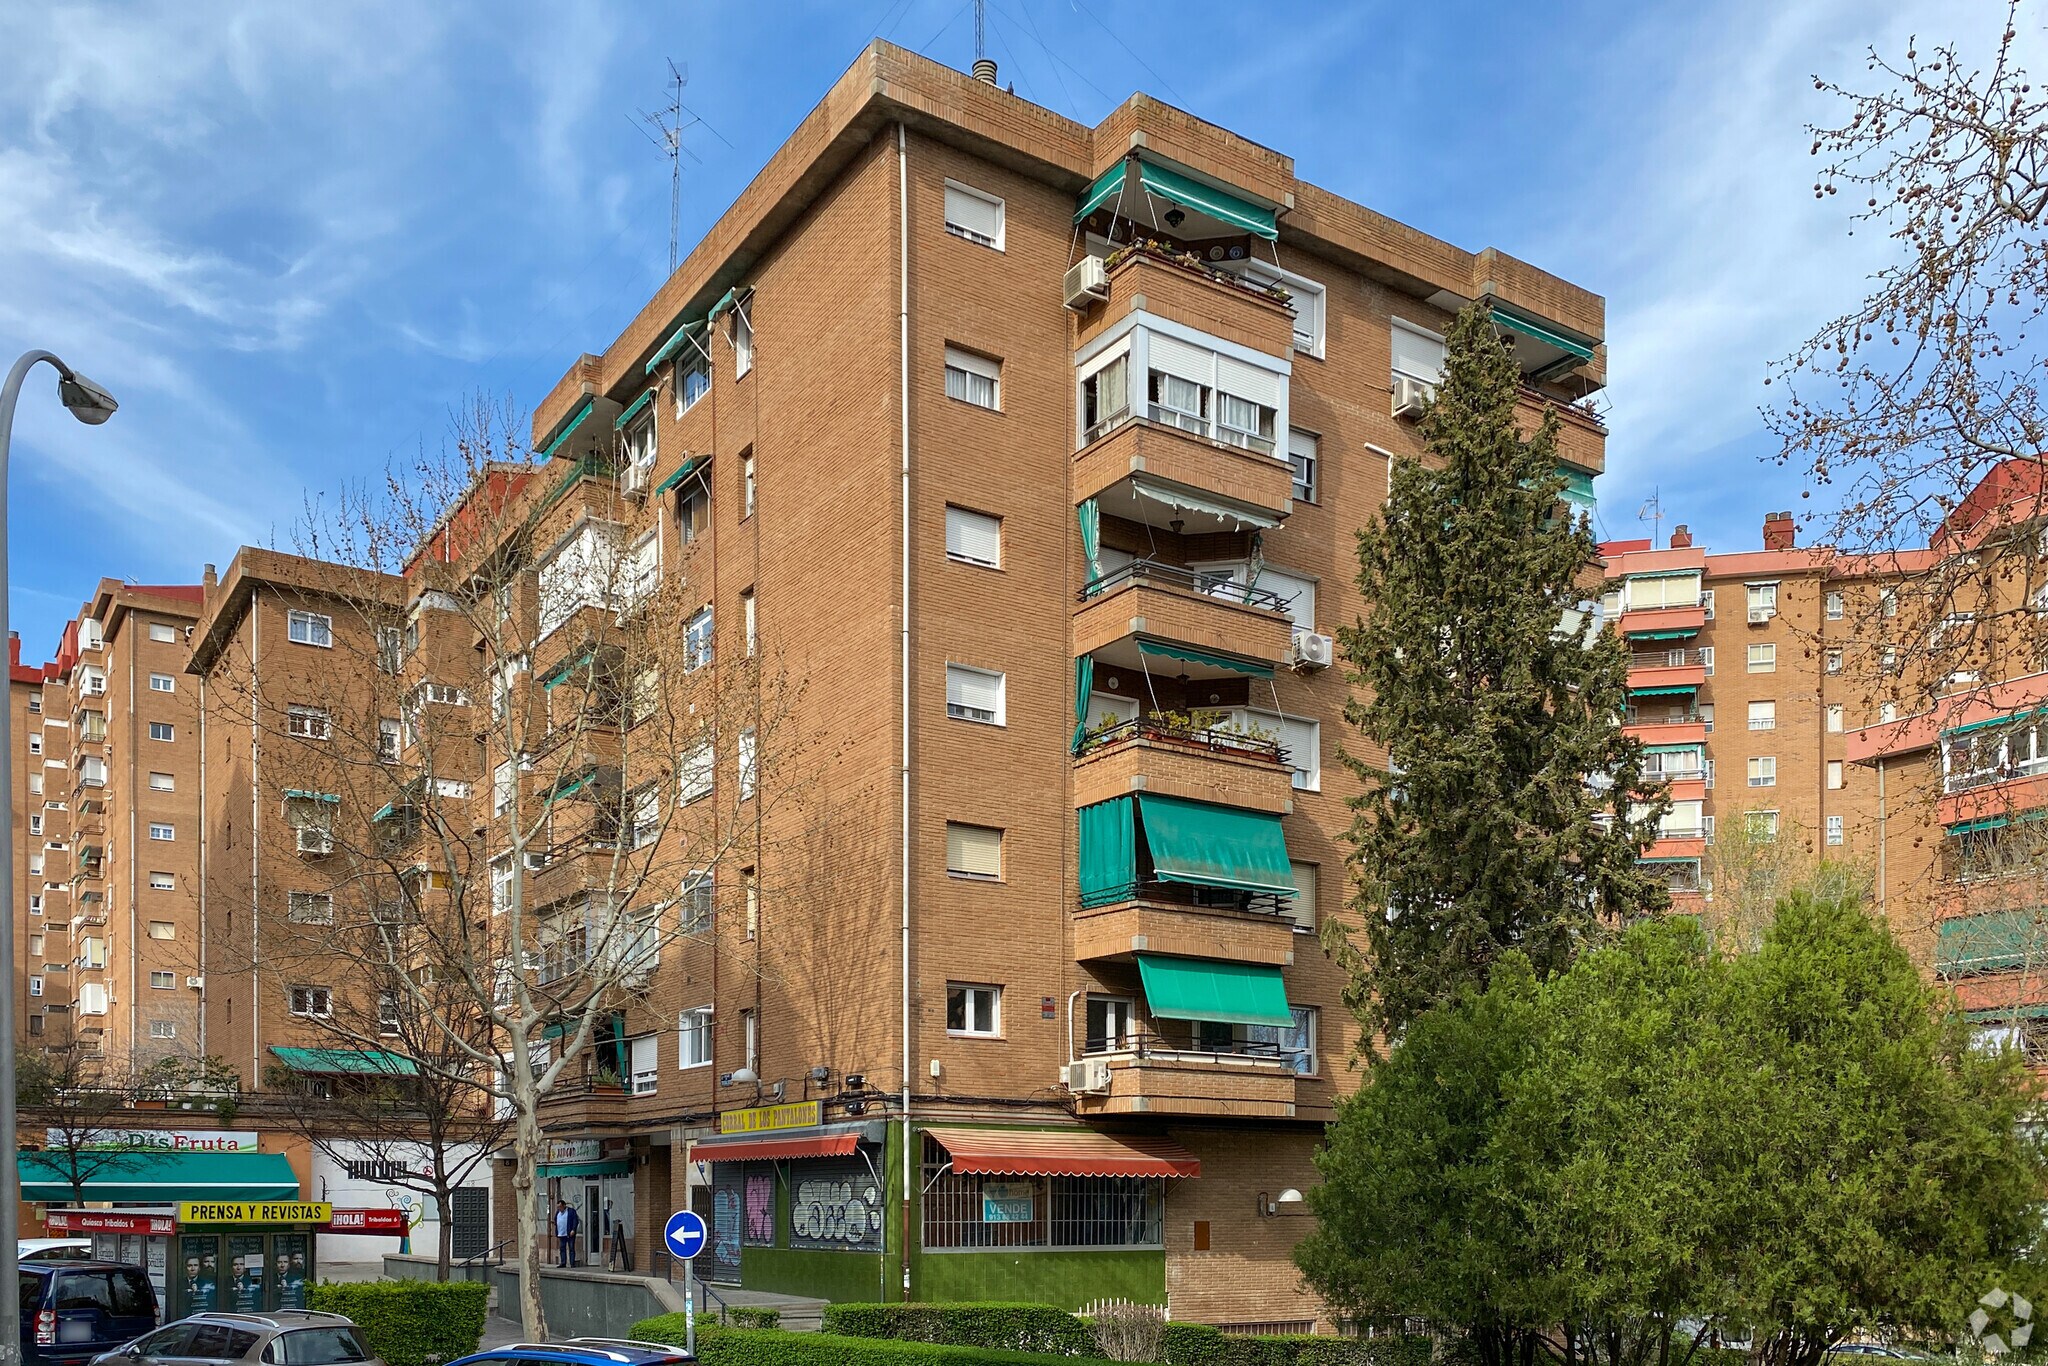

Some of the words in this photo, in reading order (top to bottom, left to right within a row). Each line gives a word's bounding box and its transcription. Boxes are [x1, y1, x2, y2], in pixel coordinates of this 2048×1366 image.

[748, 1111, 757, 1129] DE
[759, 1109, 770, 1128] LOS
[773, 1105, 816, 1126] PANTALONES
[191, 1205, 243, 1220] PRENSA
[248, 1205, 256, 1219] Y
[262, 1205, 322, 1219] REVISTAS
[989, 1203, 1028, 1214] VENDE
[81, 1218, 103, 1227] Quiosco
[104, 1218, 128, 1228] Tribaldos
[129, 1219, 134, 1228] 6
[150, 1219, 172, 1232] ¡HOLA!
[333, 1214, 364, 1226] ¡HOLA!
